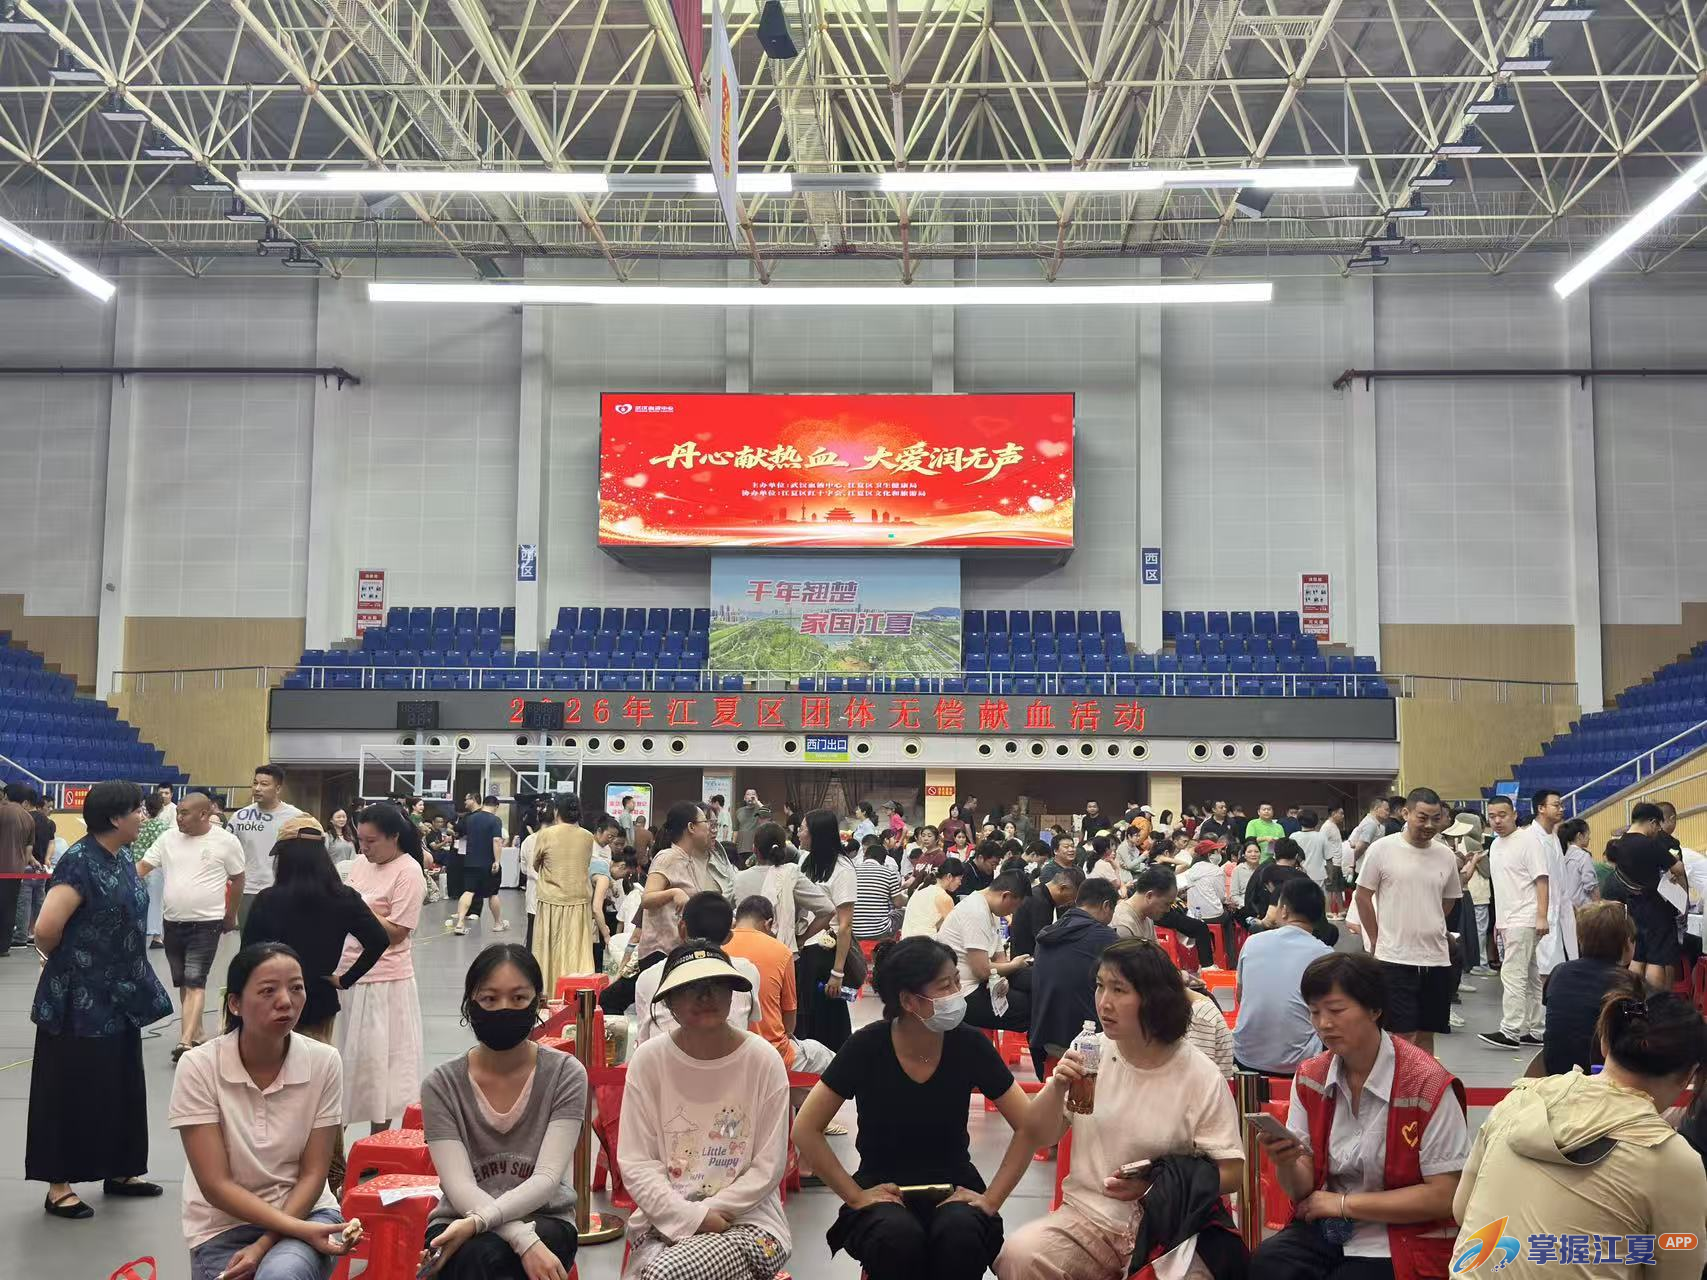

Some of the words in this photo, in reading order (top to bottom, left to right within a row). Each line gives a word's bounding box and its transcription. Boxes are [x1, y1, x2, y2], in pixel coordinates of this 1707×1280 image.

[649, 441, 849, 471] 丹心献热血
[847, 440, 1025, 486] 大爱润无声
[1144, 552, 1158, 581] 西区
[746, 579, 858, 603] 千年翘楚
[800, 612, 914, 635] 家国江夏
[510, 697, 1147, 732] 226年江夏区团体无偿献血活动
[806, 738, 847, 750] 西门出口
[702, 1146, 727, 1156] Little
